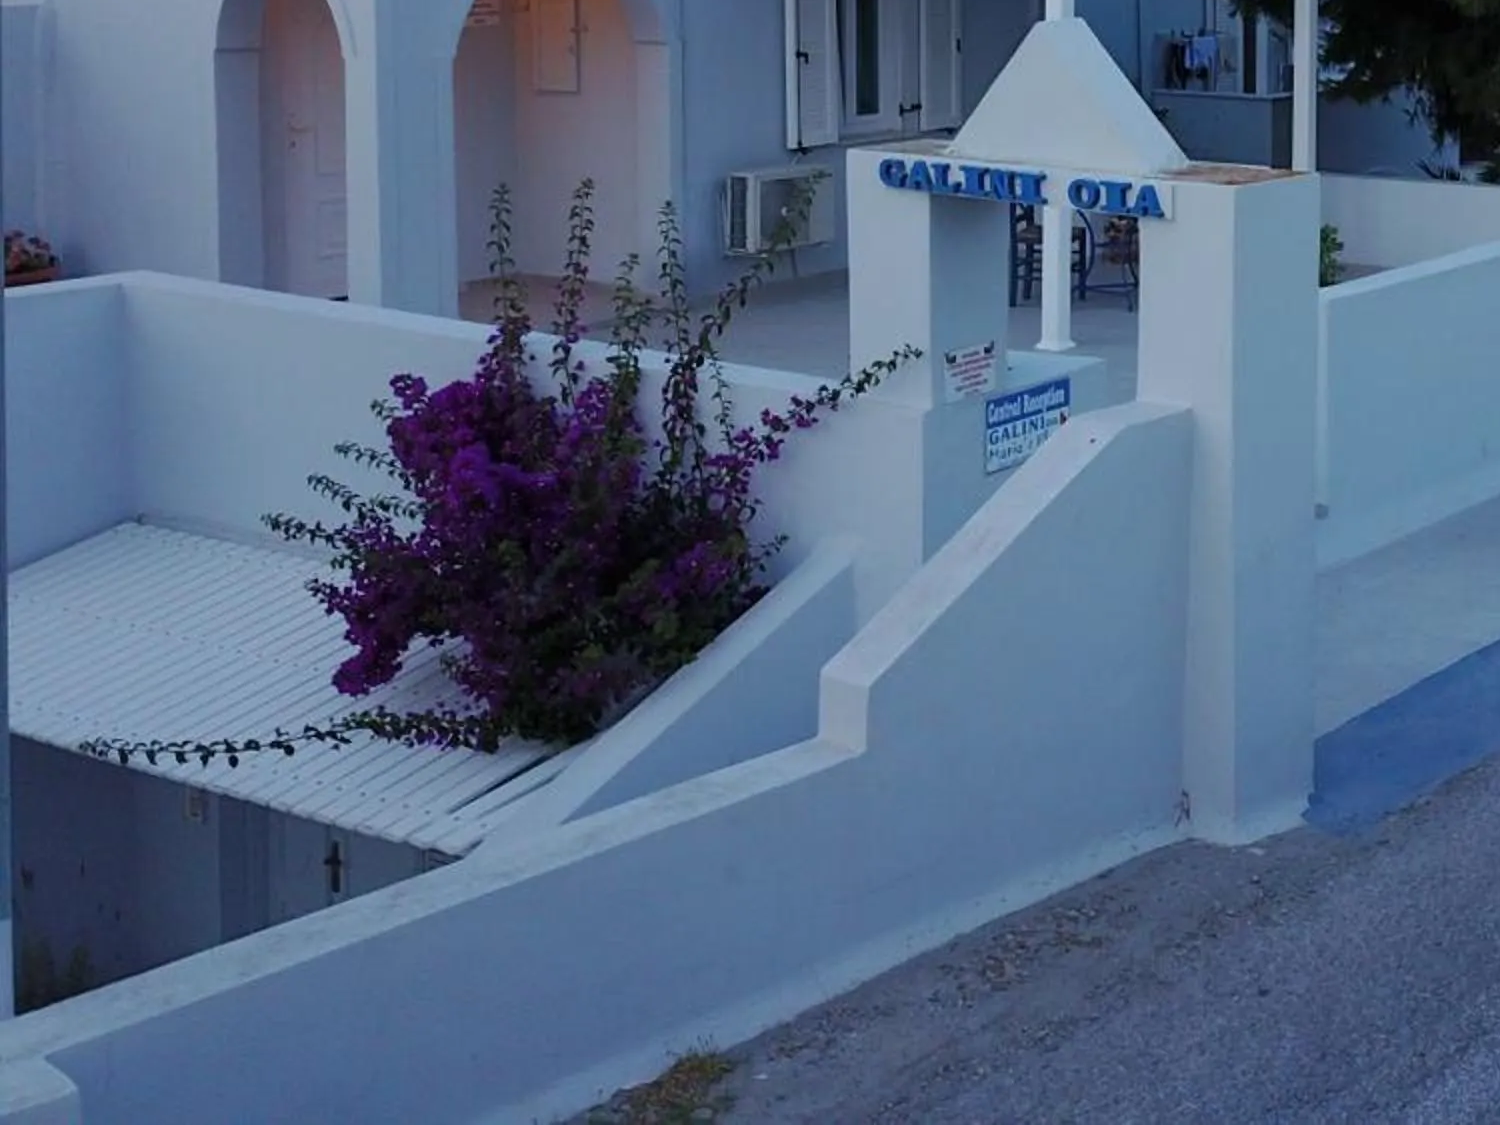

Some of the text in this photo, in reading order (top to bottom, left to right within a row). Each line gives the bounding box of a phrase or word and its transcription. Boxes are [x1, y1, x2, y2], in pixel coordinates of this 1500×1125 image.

[879, 158, 1165, 218] GALINI OIA
[989, 416, 1045, 446] GALINI
